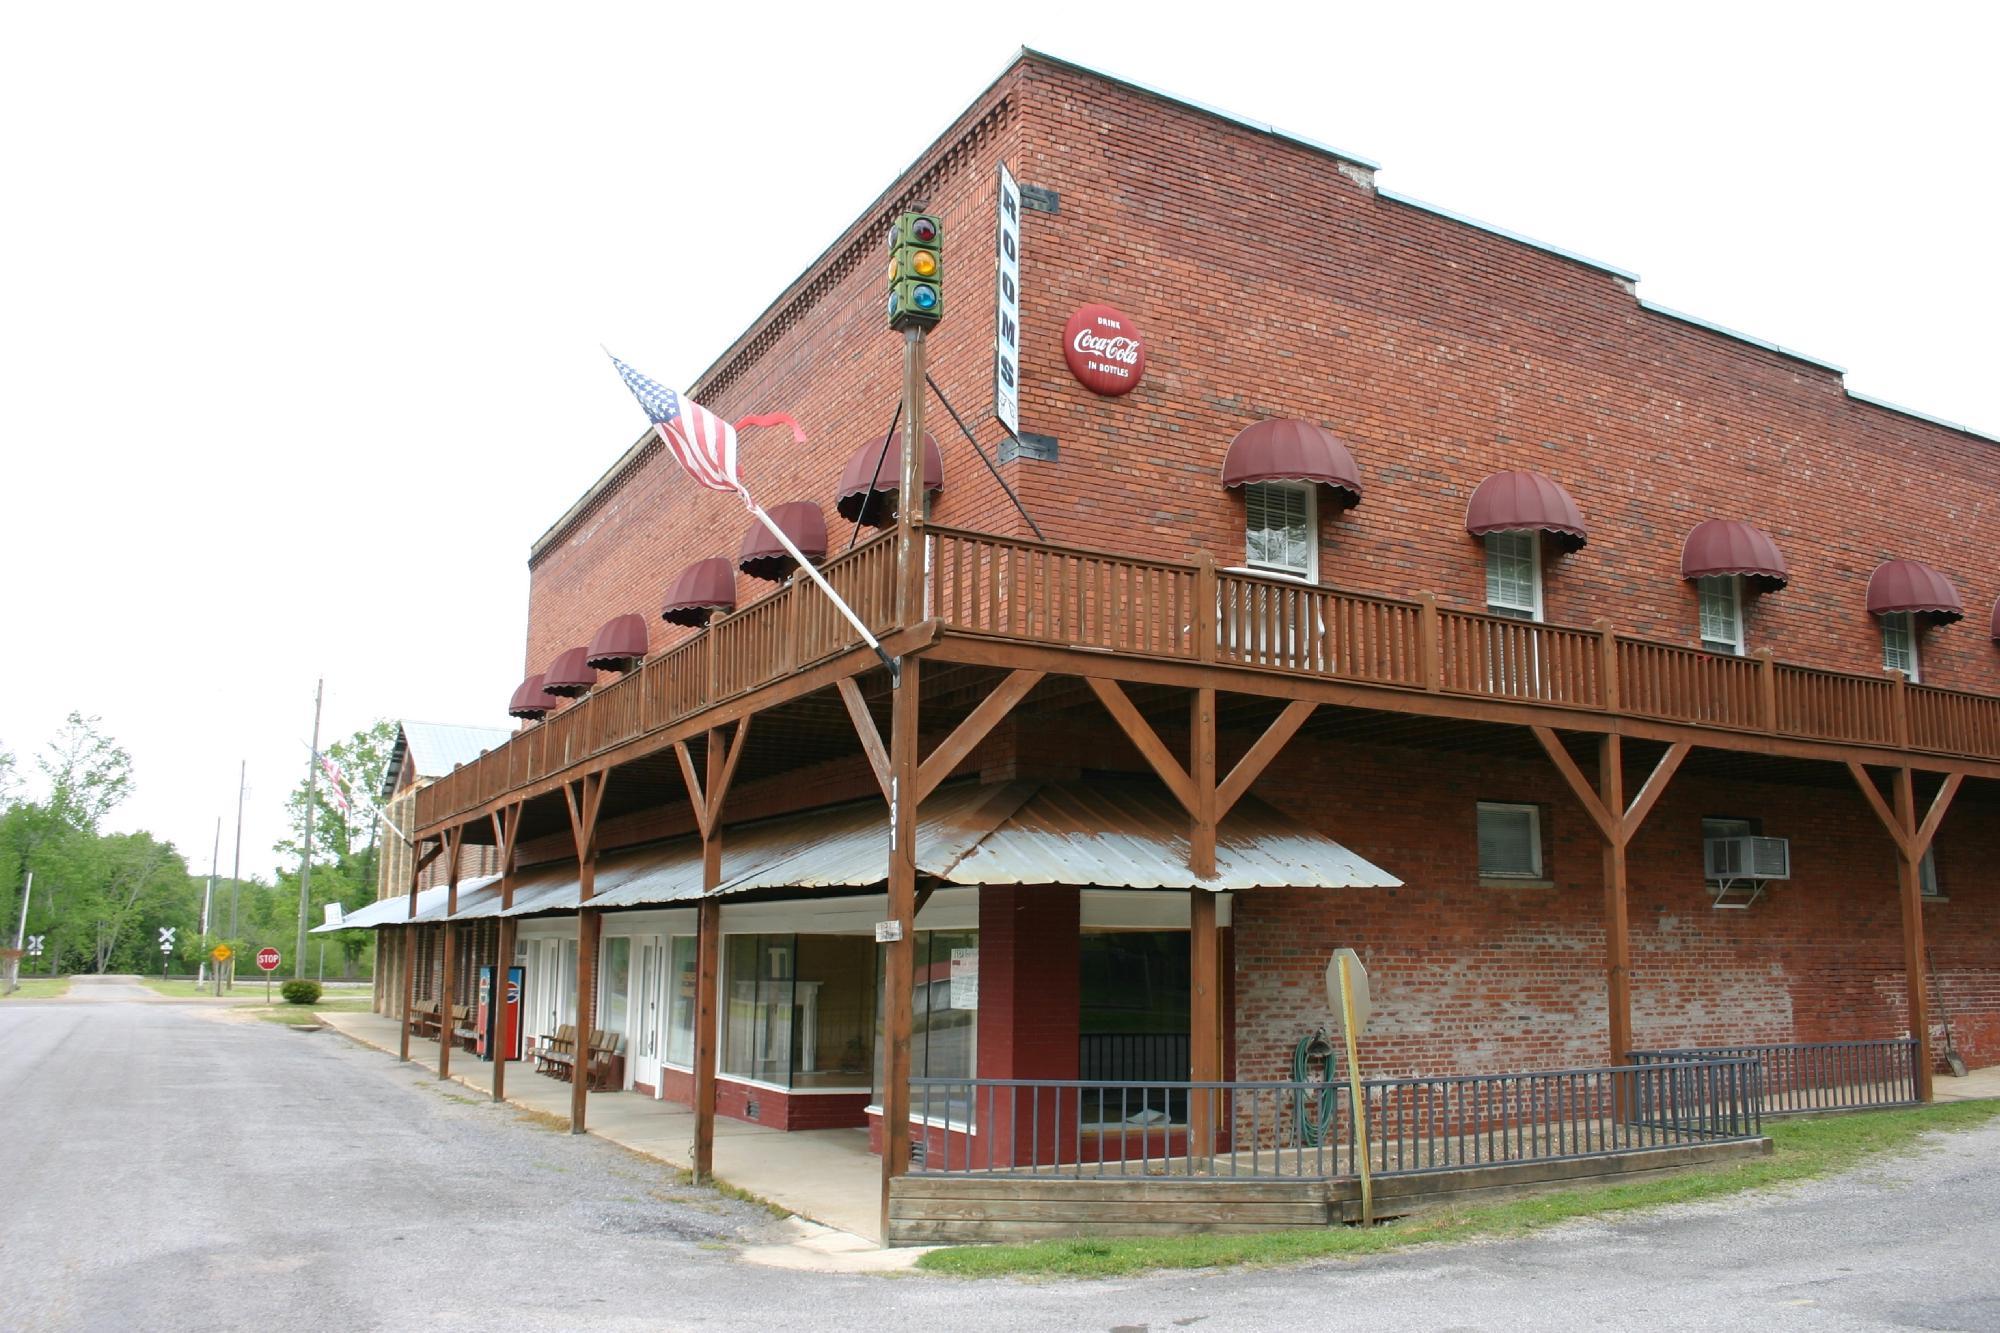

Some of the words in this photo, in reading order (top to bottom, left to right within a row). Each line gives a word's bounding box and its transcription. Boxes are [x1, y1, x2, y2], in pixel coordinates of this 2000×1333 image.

[1001, 185, 1016, 388] ROOMS
[1097, 316, 1121, 330] DRINK
[1073, 328, 1139, 364] Coca-Cola
[1088, 360, 1097, 371] IN
[1099, 363, 1129, 378] BOTTLES
[890, 776, 898, 850] 131
[259, 954, 279, 963] STOP
